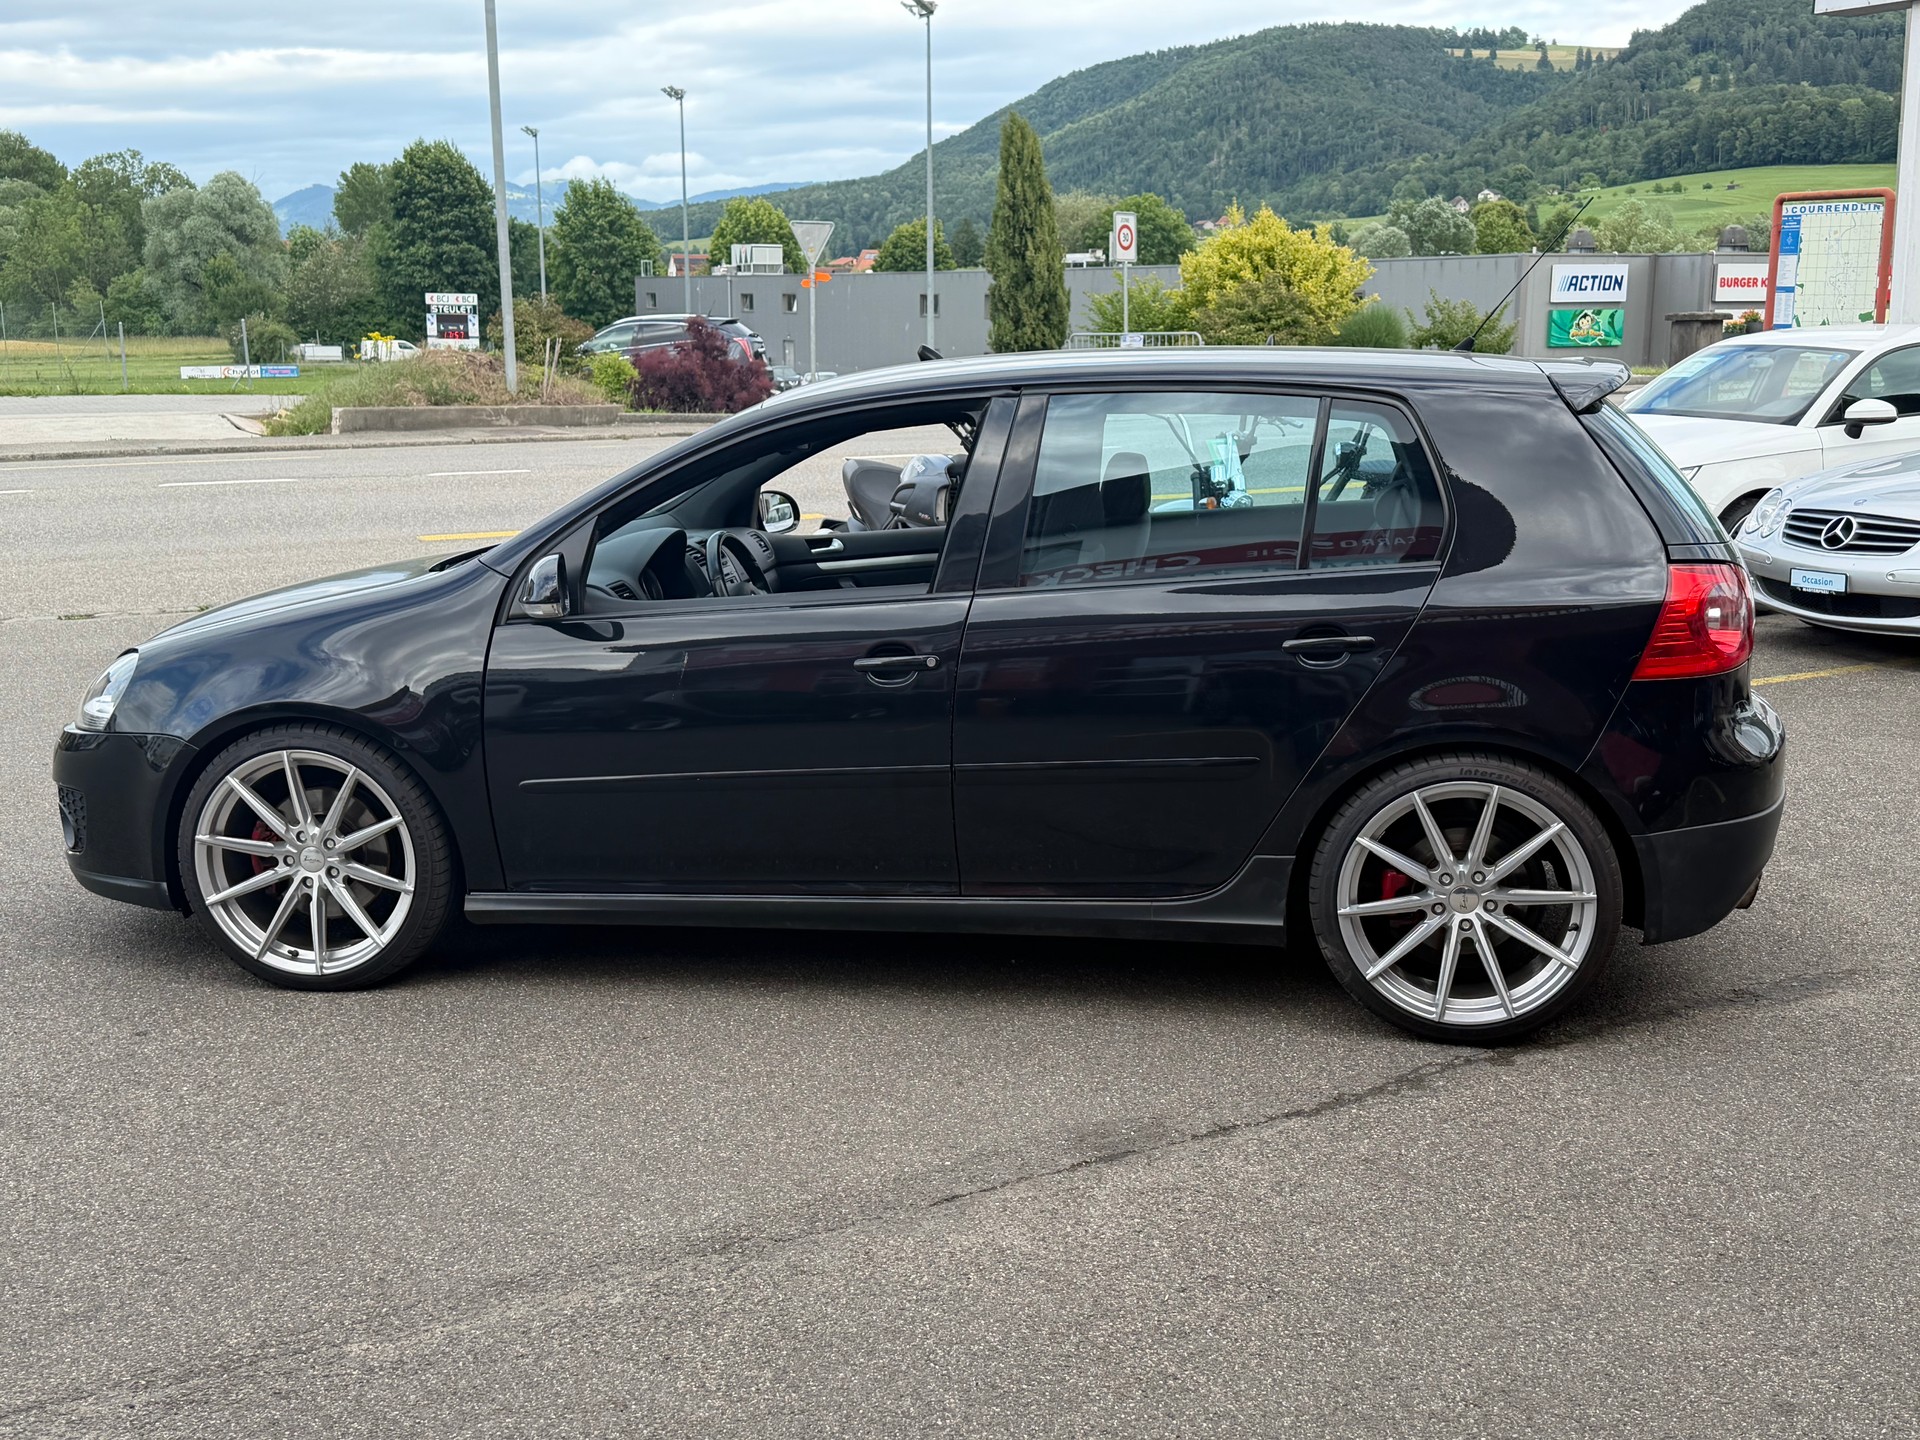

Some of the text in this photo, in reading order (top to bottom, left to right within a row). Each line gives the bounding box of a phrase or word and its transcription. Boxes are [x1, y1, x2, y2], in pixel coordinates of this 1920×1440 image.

[1791, 203, 1881, 214] COURRENDLIN
[1122, 232, 1129, 242] 30
[1567, 275, 1624, 291] ACTION
[1719, 277, 1758, 288] BURGER
[436, 295, 450, 303] BCJ
[1801, 575, 1834, 586] Occasion
[399, 795, 417, 821] STAR
